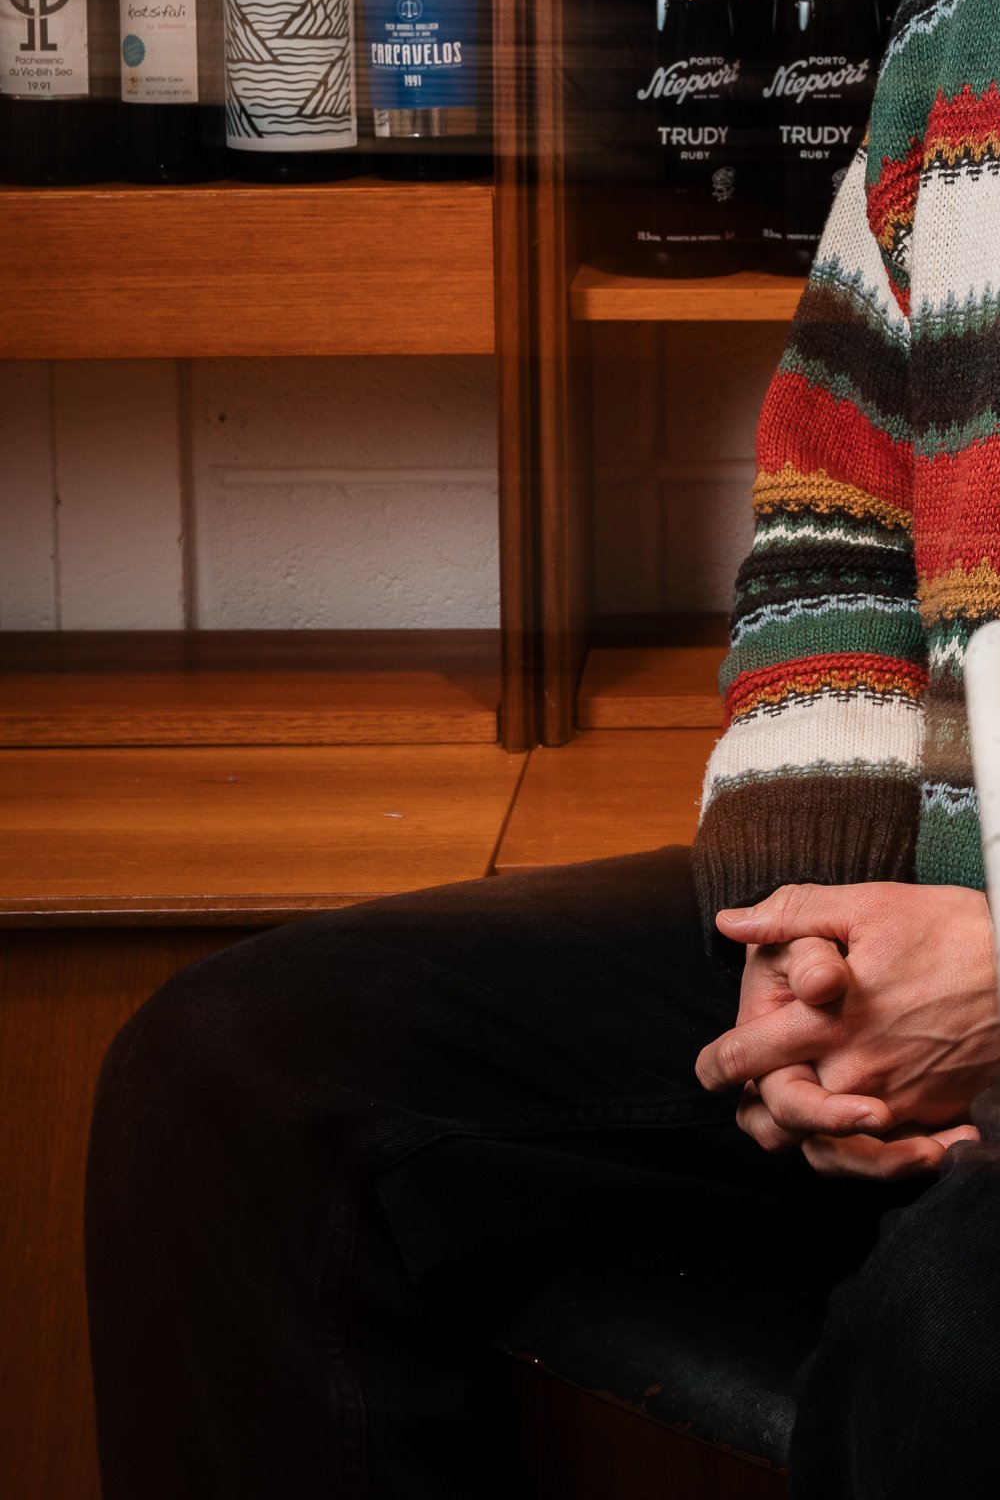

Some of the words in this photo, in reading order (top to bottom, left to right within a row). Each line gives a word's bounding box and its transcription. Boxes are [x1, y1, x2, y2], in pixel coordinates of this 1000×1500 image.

[128, 3, 186, 19] kotsifali
[371, 41, 463, 66] CARCAVELOS
[15, 56, 64, 65] Pacherenc
[689, 57, 724, 65] PORTO
[808, 56, 846, 65] PORTO
[9, 67, 20, 76] du
[55, 67, 73, 76] Sec
[404, 74, 422, 87] 1991
[637, 58, 740, 105] Niepoort
[762, 58, 869, 104] Niepoort
[657, 126, 729, 146] TRUDY
[779, 125, 853, 144] TRUDY
[681, 151, 711, 160] RUBY
[800, 150, 831, 159] RUBY
